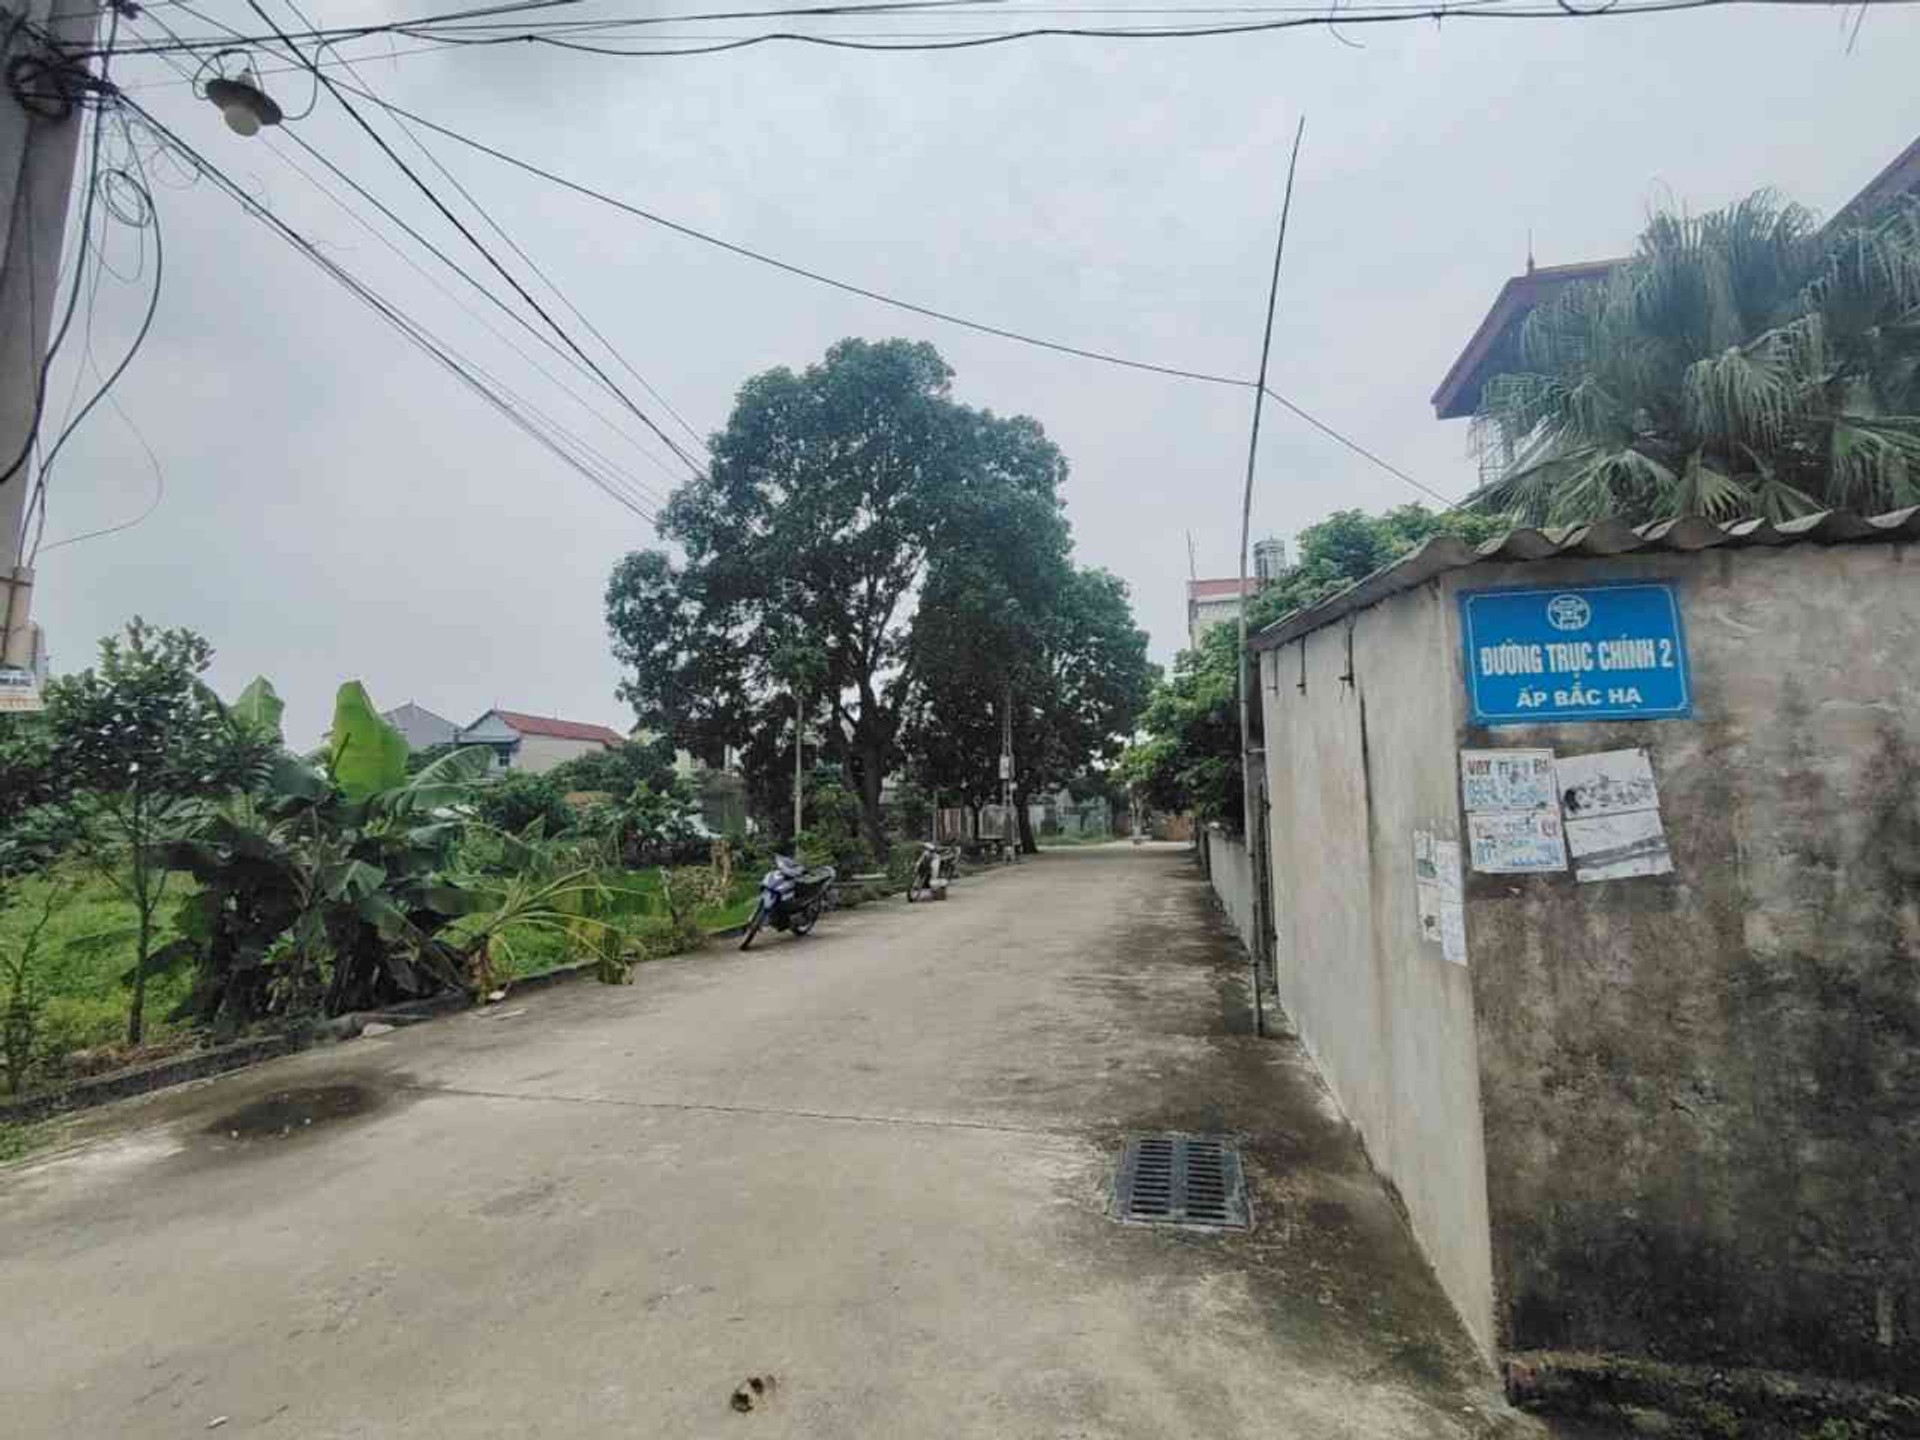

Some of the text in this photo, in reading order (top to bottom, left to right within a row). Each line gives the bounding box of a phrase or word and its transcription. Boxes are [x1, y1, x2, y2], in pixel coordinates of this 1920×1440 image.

[1546, 642, 1593, 679] TRỤC
[1598, 634, 1656, 670] CHÍNH
[1660, 638, 1674, 668] 2
[1554, 681, 1602, 706] BẮC
[1608, 687, 1643, 708] HẠ
